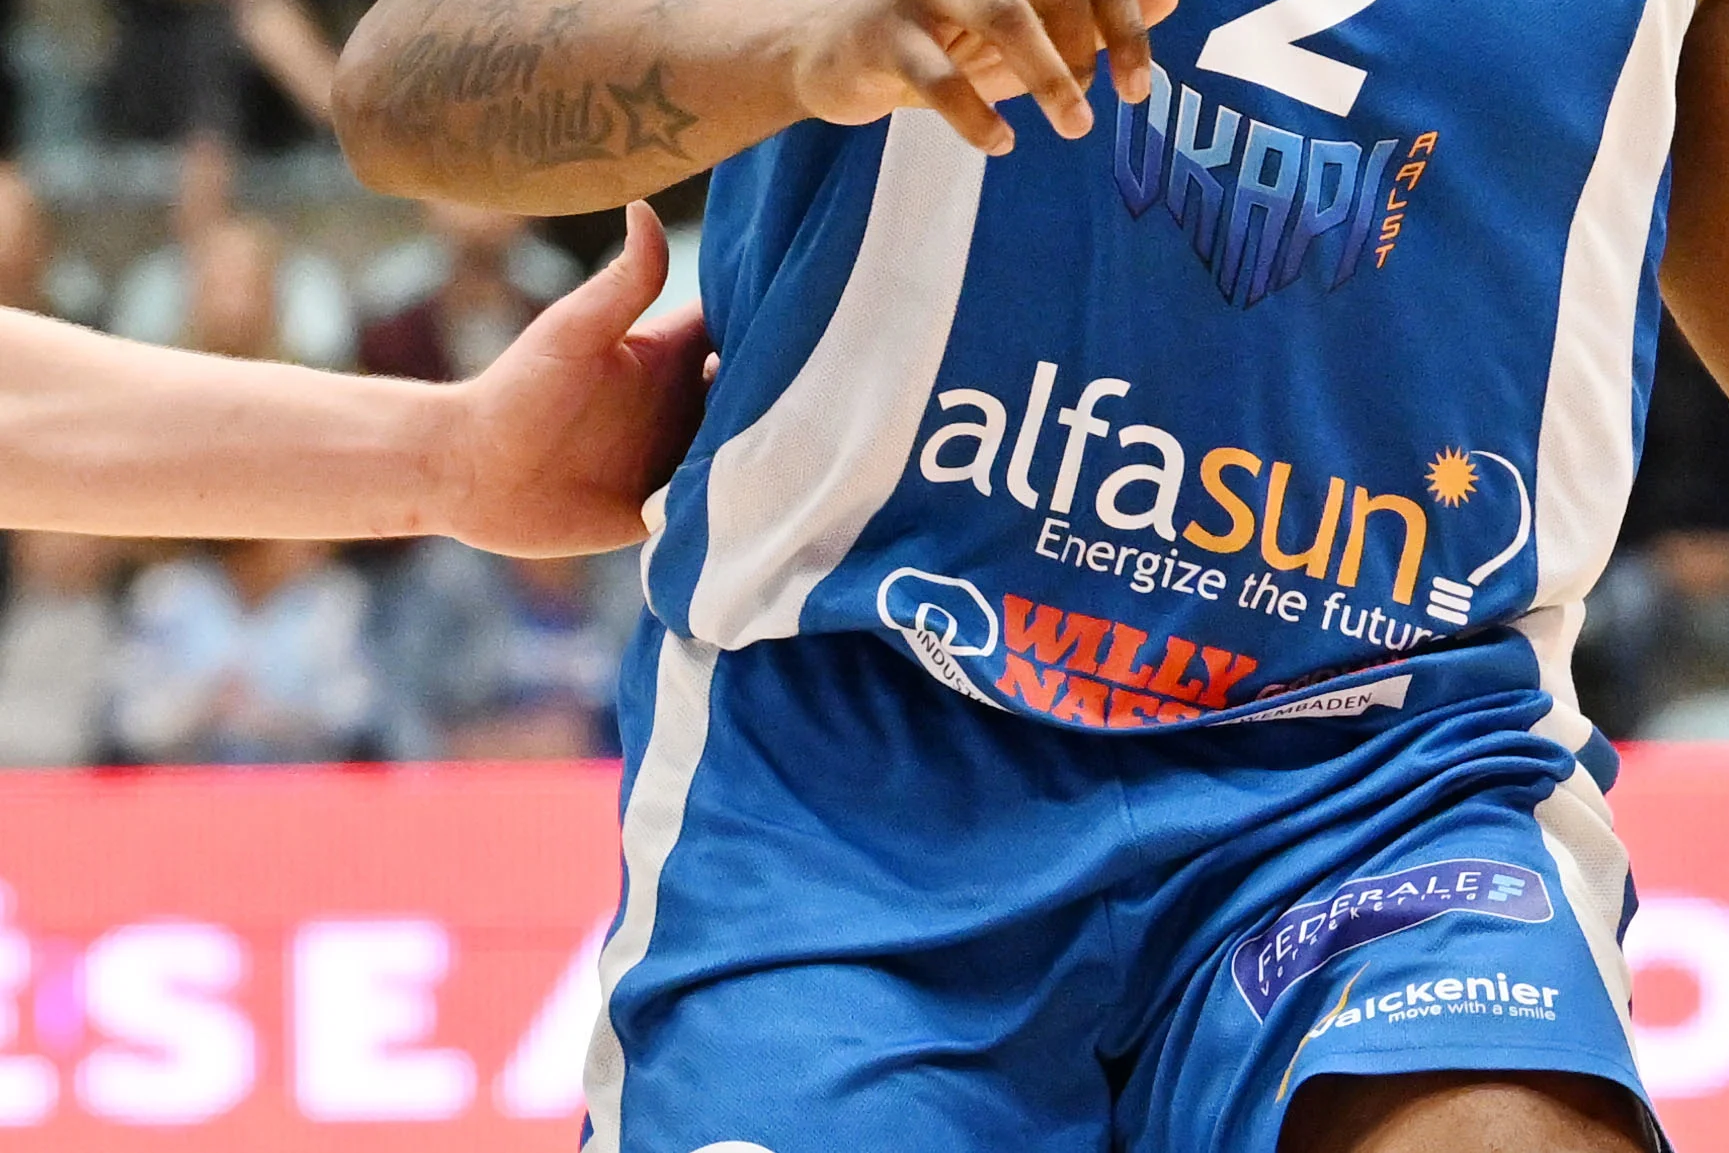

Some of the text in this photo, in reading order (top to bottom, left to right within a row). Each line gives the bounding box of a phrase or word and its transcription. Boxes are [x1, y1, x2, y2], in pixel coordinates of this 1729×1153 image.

[1113, 58, 1399, 311] OKAPI
[1375, 131, 1439, 270] AALST
[919, 359, 1428, 605] alfasun
[1034, 517, 1227, 601] Energize
[1237, 572, 1307, 622] the
[1002, 592, 1258, 709] WILLY
[1257, 871, 1482, 983] FEDERALE
[1388, 999, 1557, 1024] move with a smile
